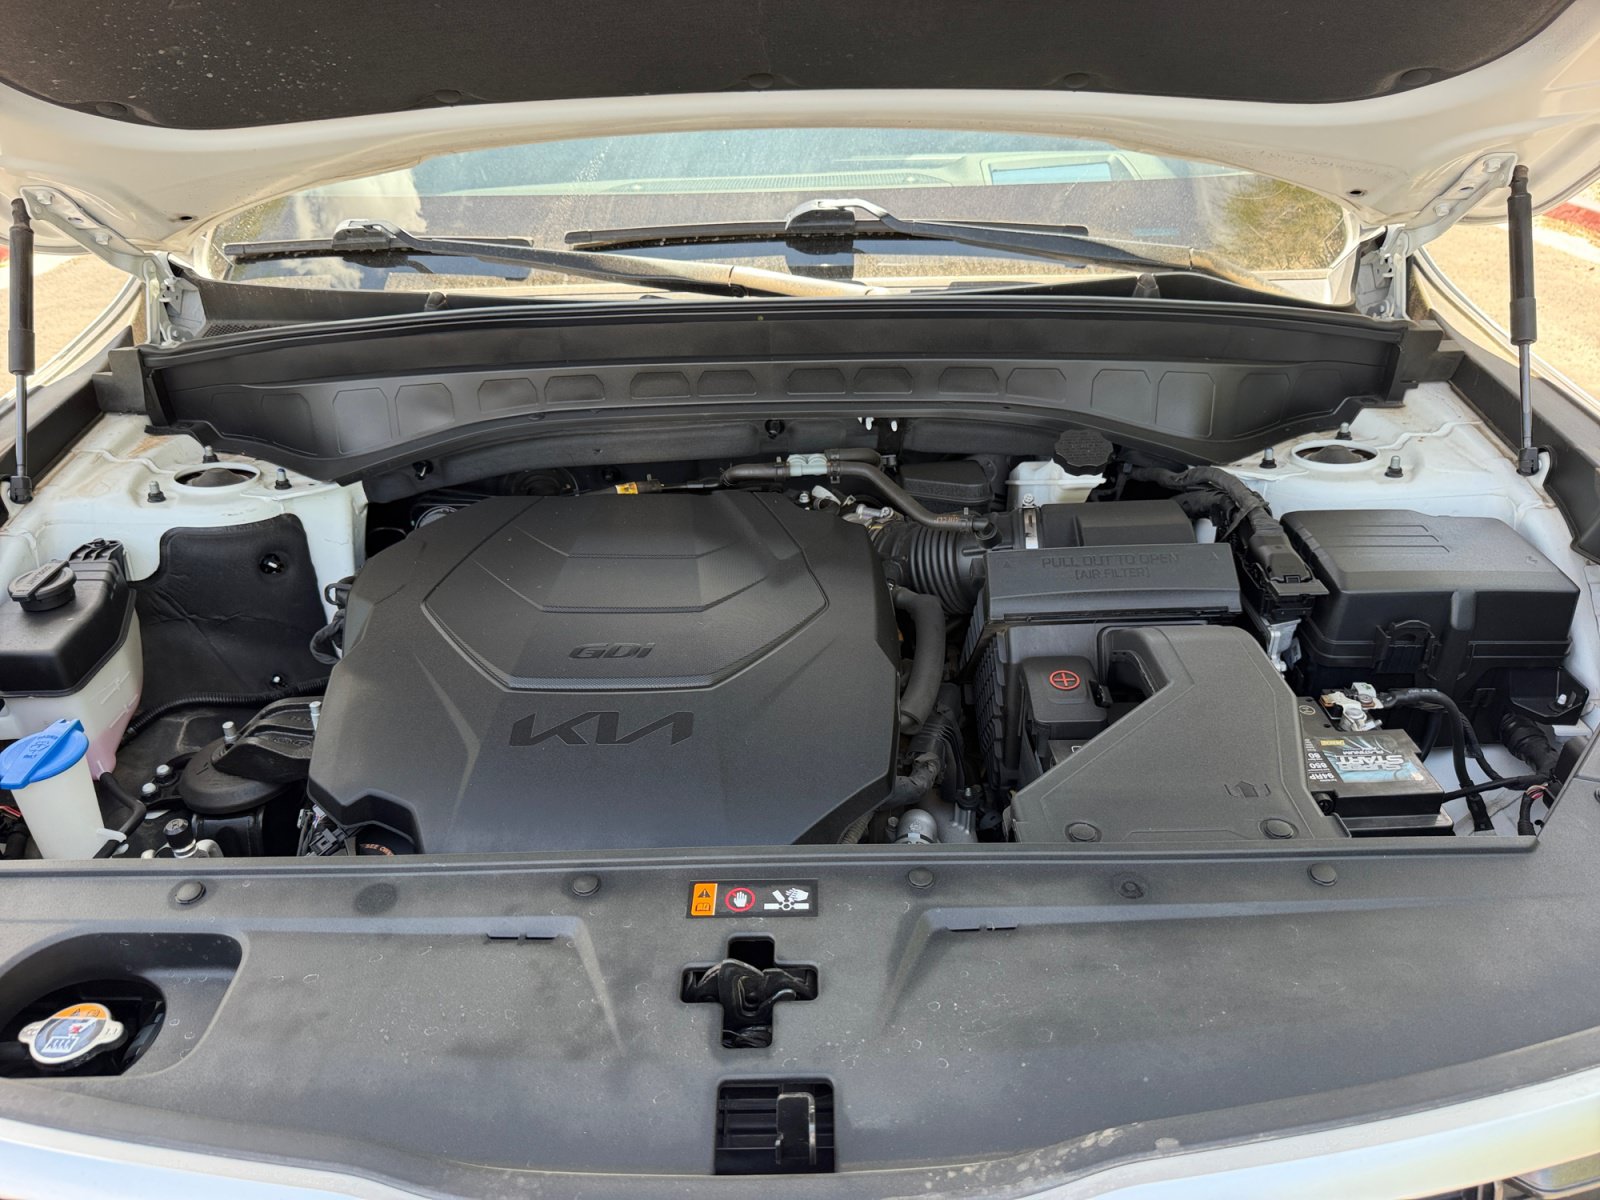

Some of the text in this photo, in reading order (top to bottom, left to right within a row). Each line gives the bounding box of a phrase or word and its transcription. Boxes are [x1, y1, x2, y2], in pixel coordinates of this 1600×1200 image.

[1041, 552, 1179, 568] PULL OUT TO OPEN
[509, 711, 695, 747] KIA
[1335, 755, 1404, 765] START
[1309, 772, 1336, 780] 94RP
